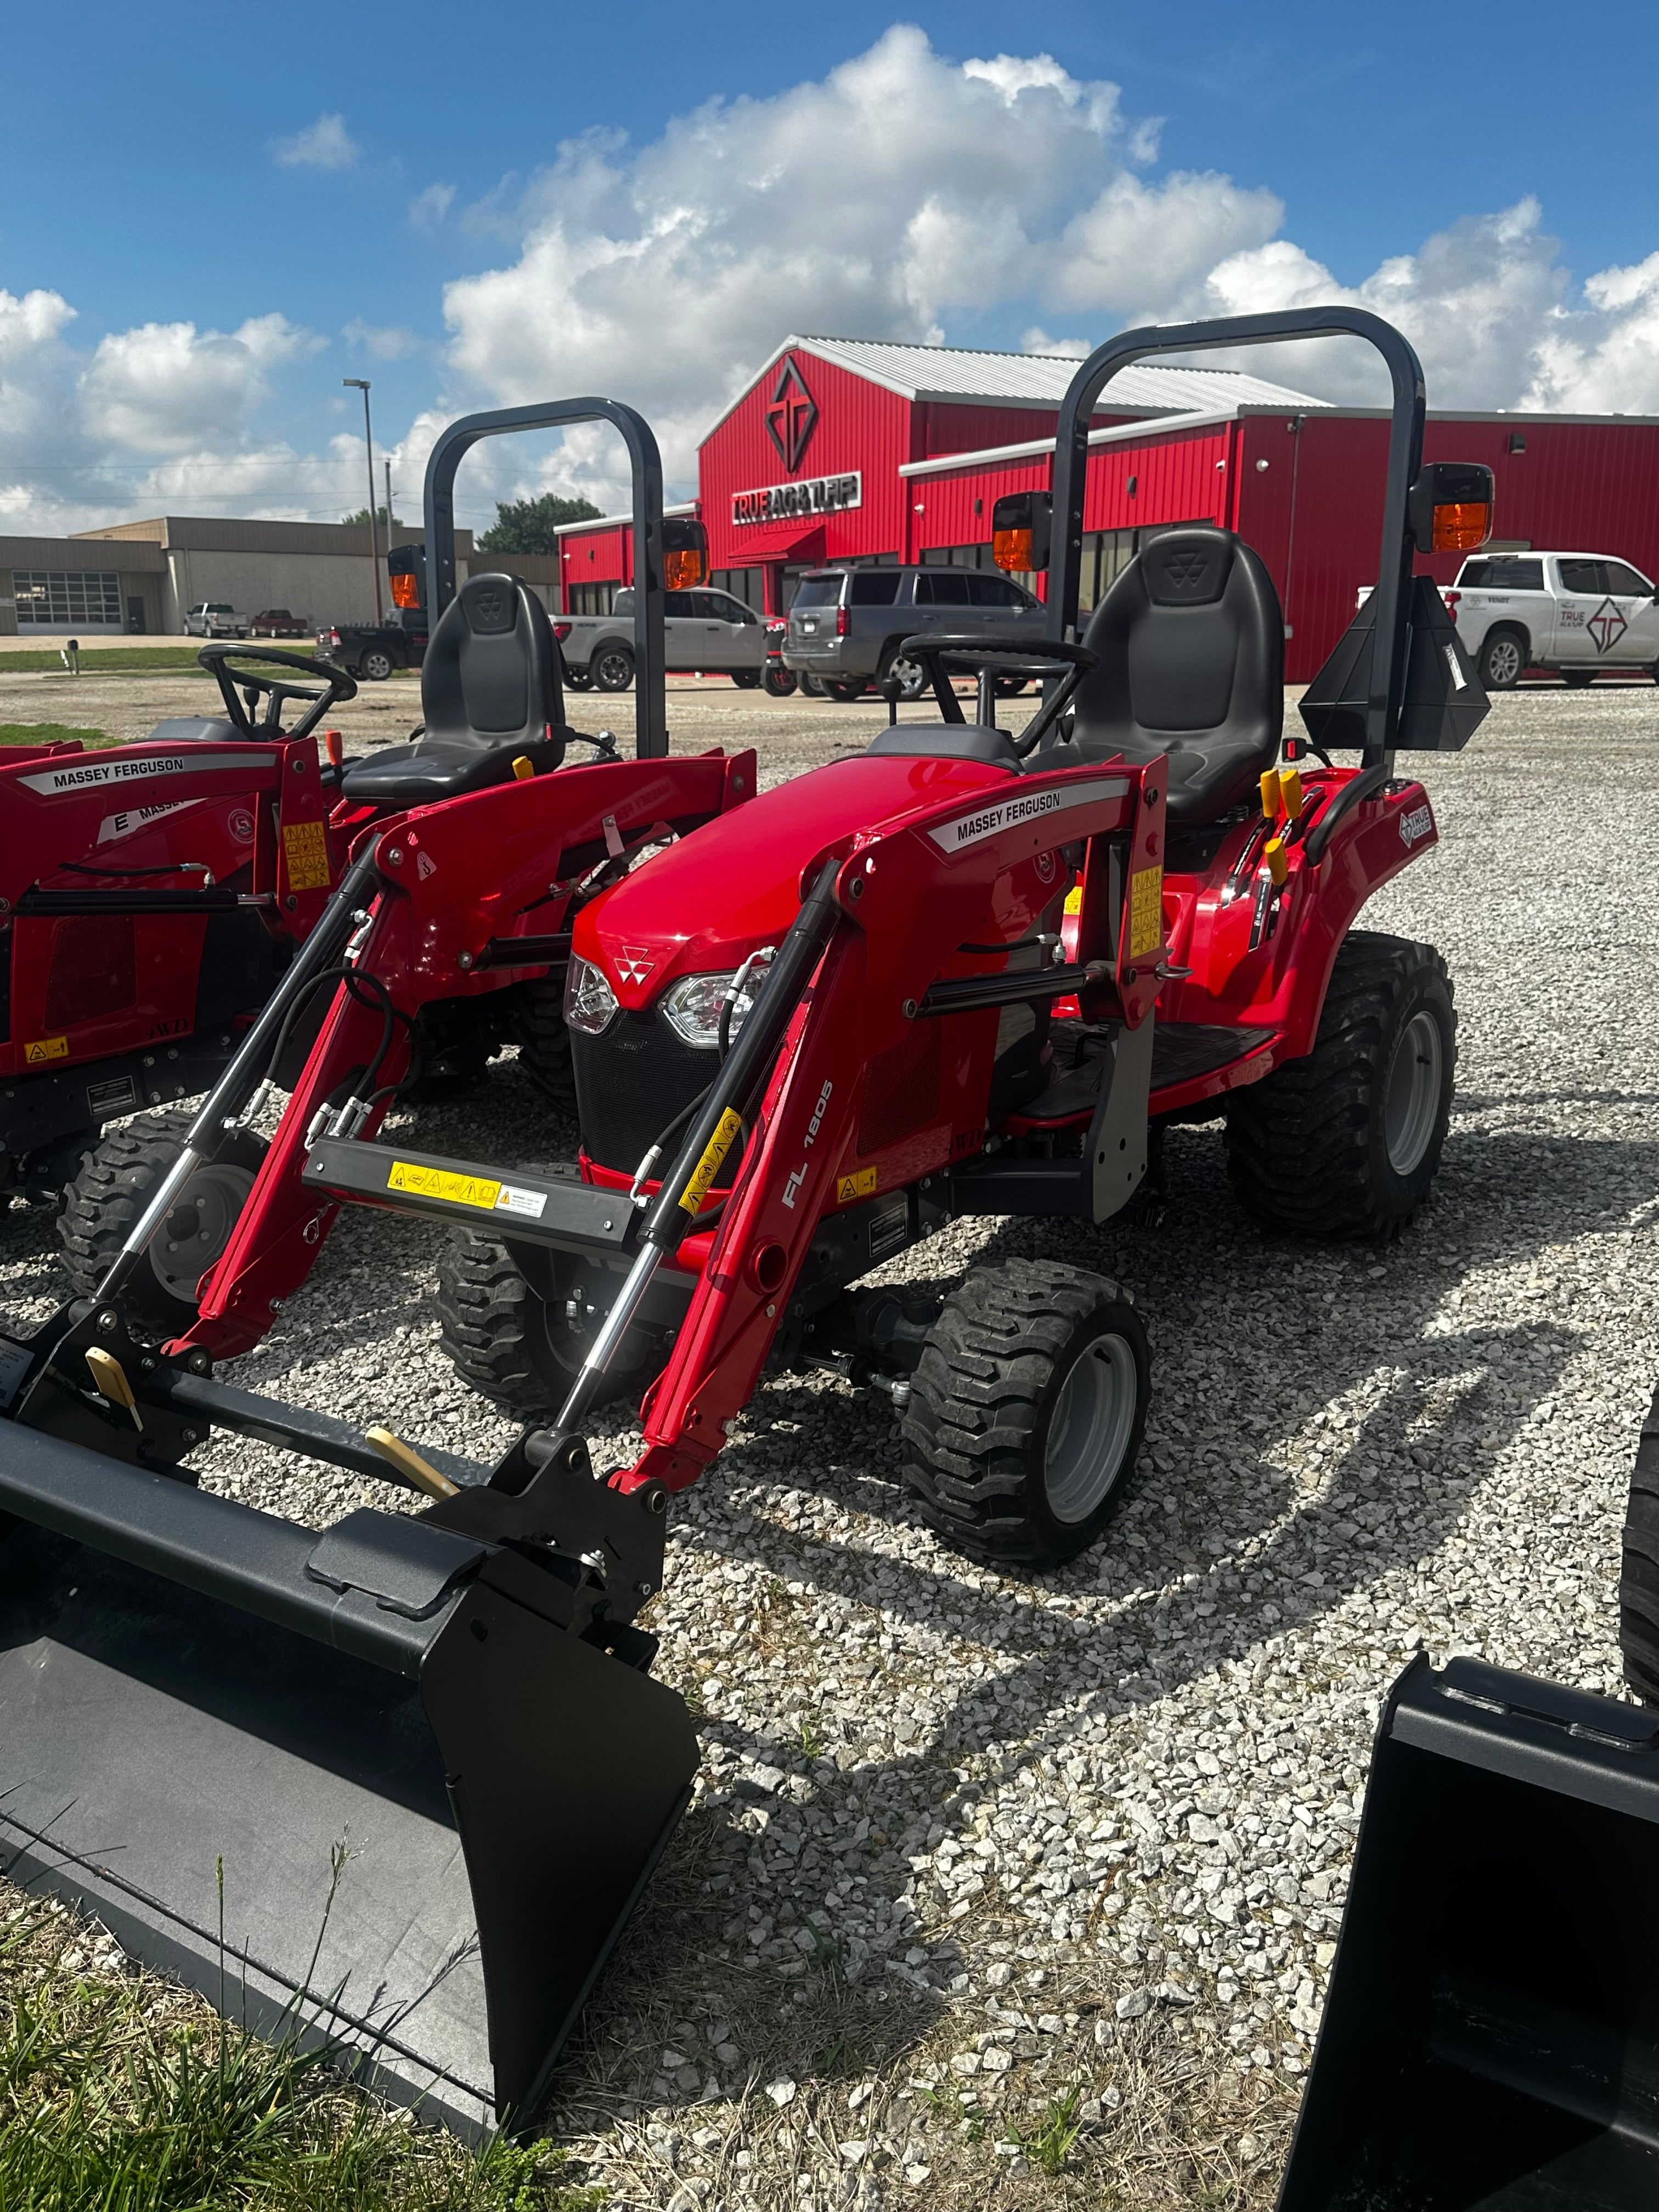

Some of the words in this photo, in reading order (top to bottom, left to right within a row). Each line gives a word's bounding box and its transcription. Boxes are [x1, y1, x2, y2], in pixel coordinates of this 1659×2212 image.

[730, 490, 768, 520] TRUE
[1561, 611, 1585, 622] TRUE
[54, 768, 109, 787] MASSEY
[115, 759, 183, 777] FERGUSON
[139, 800, 184, 820] MASS
[958, 809, 1003, 841] MASSEY
[1006, 792, 1060, 822] FERGUSON
[1409, 807, 1429, 828] TRUE
[144, 1018, 188, 1040] 4WD
[781, 1162, 808, 1209] FL
[804, 1079, 833, 1148] 1805
[945, 1128, 981, 1155] 4WD
